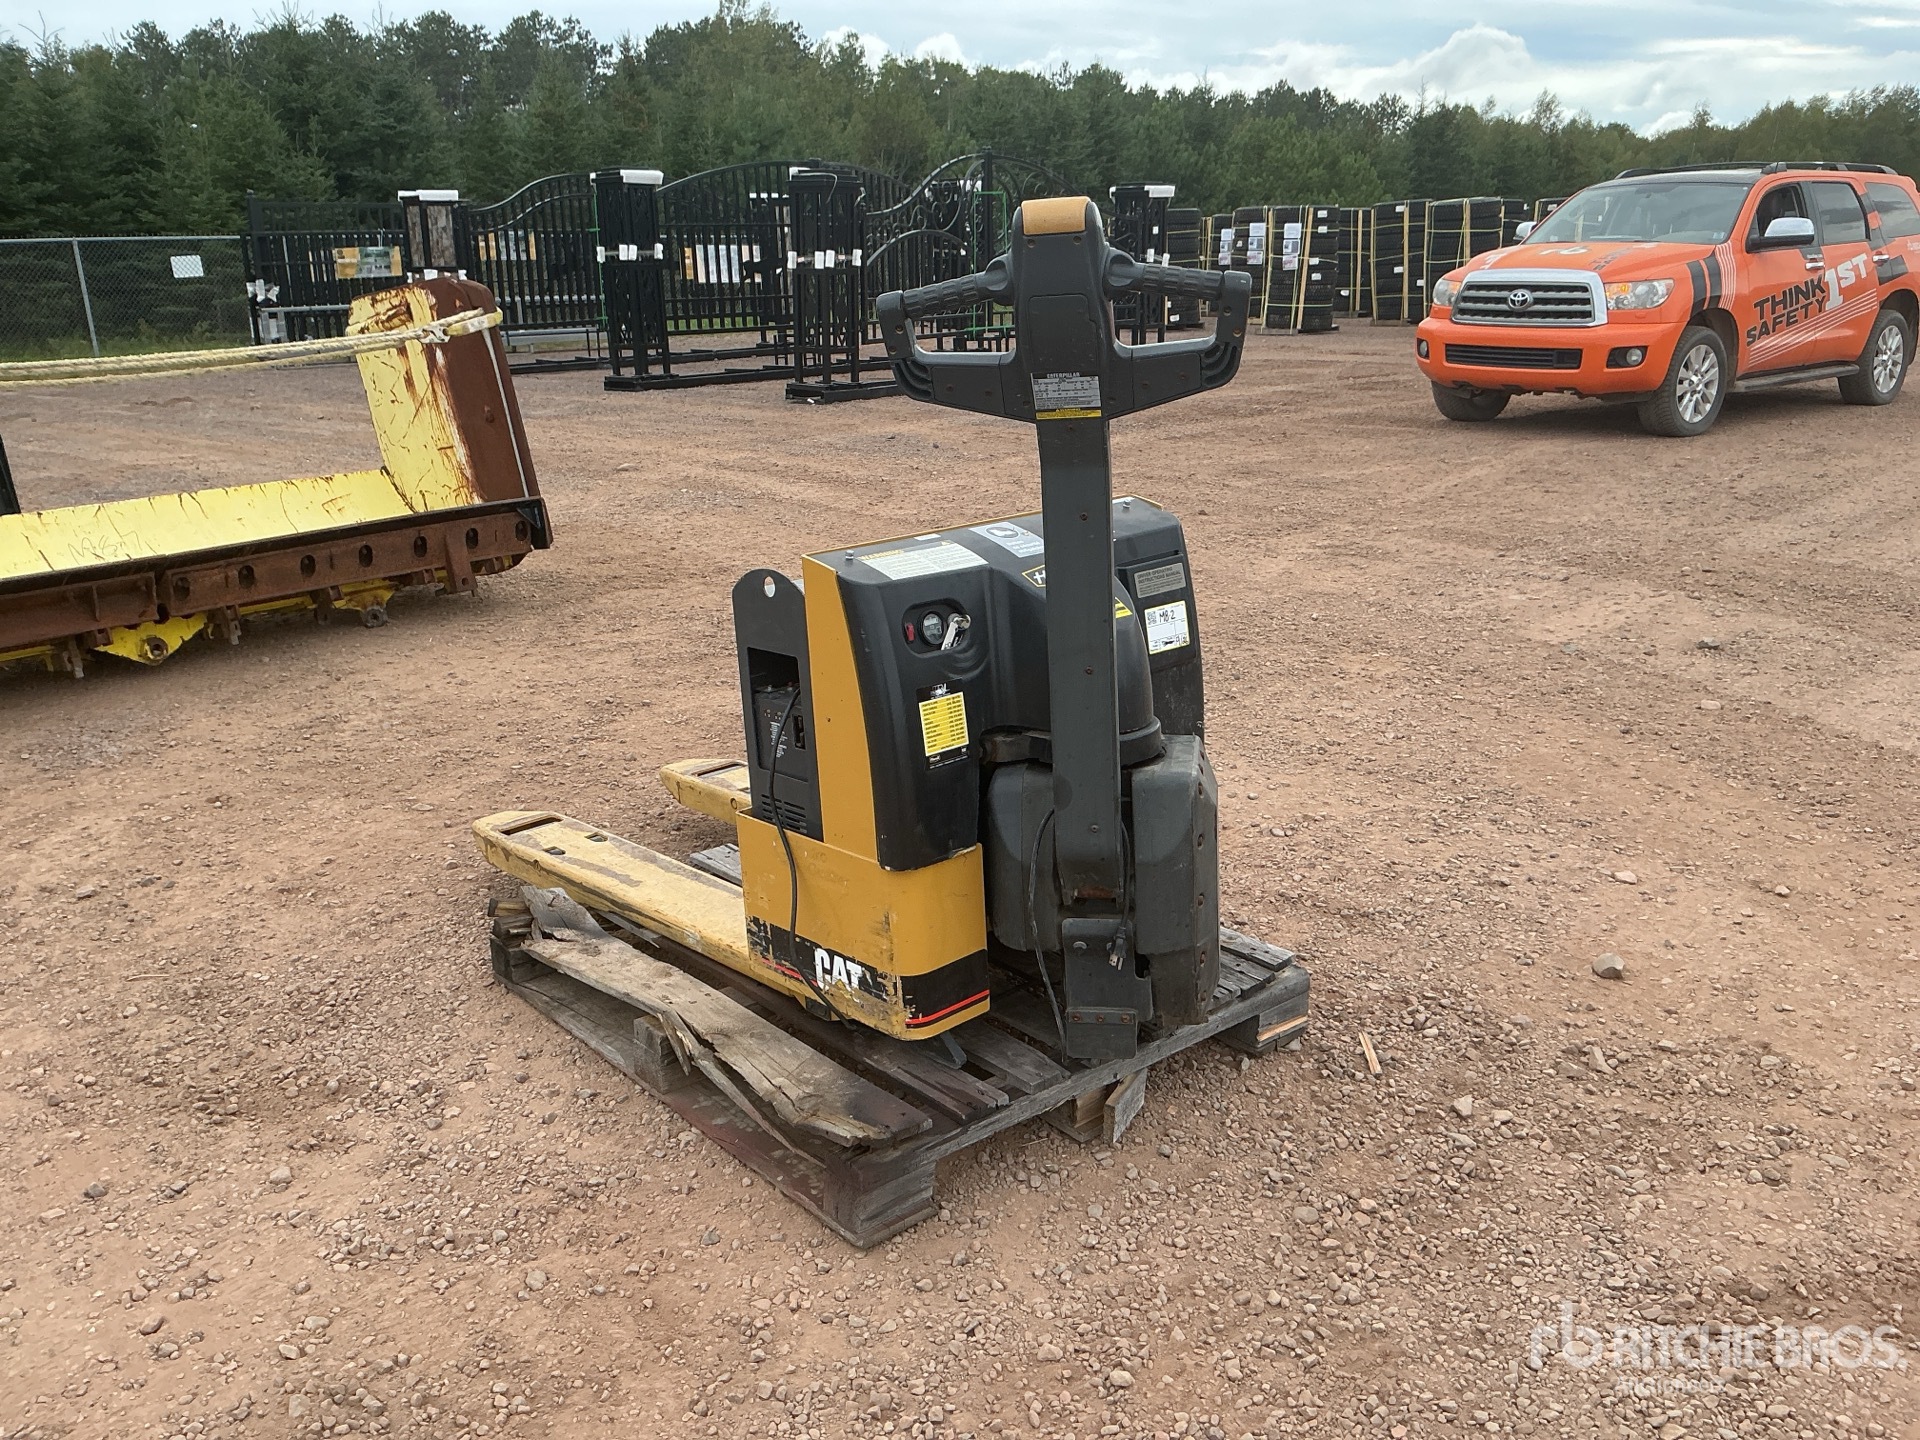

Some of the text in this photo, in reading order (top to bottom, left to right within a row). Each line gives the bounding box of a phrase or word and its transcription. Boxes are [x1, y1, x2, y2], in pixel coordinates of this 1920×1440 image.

[1753, 274, 1826, 320] THINK
[1824, 253, 1868, 311] 1ST
[1746, 296, 1826, 347] SAFETY
[814, 948, 862, 991] CAT
